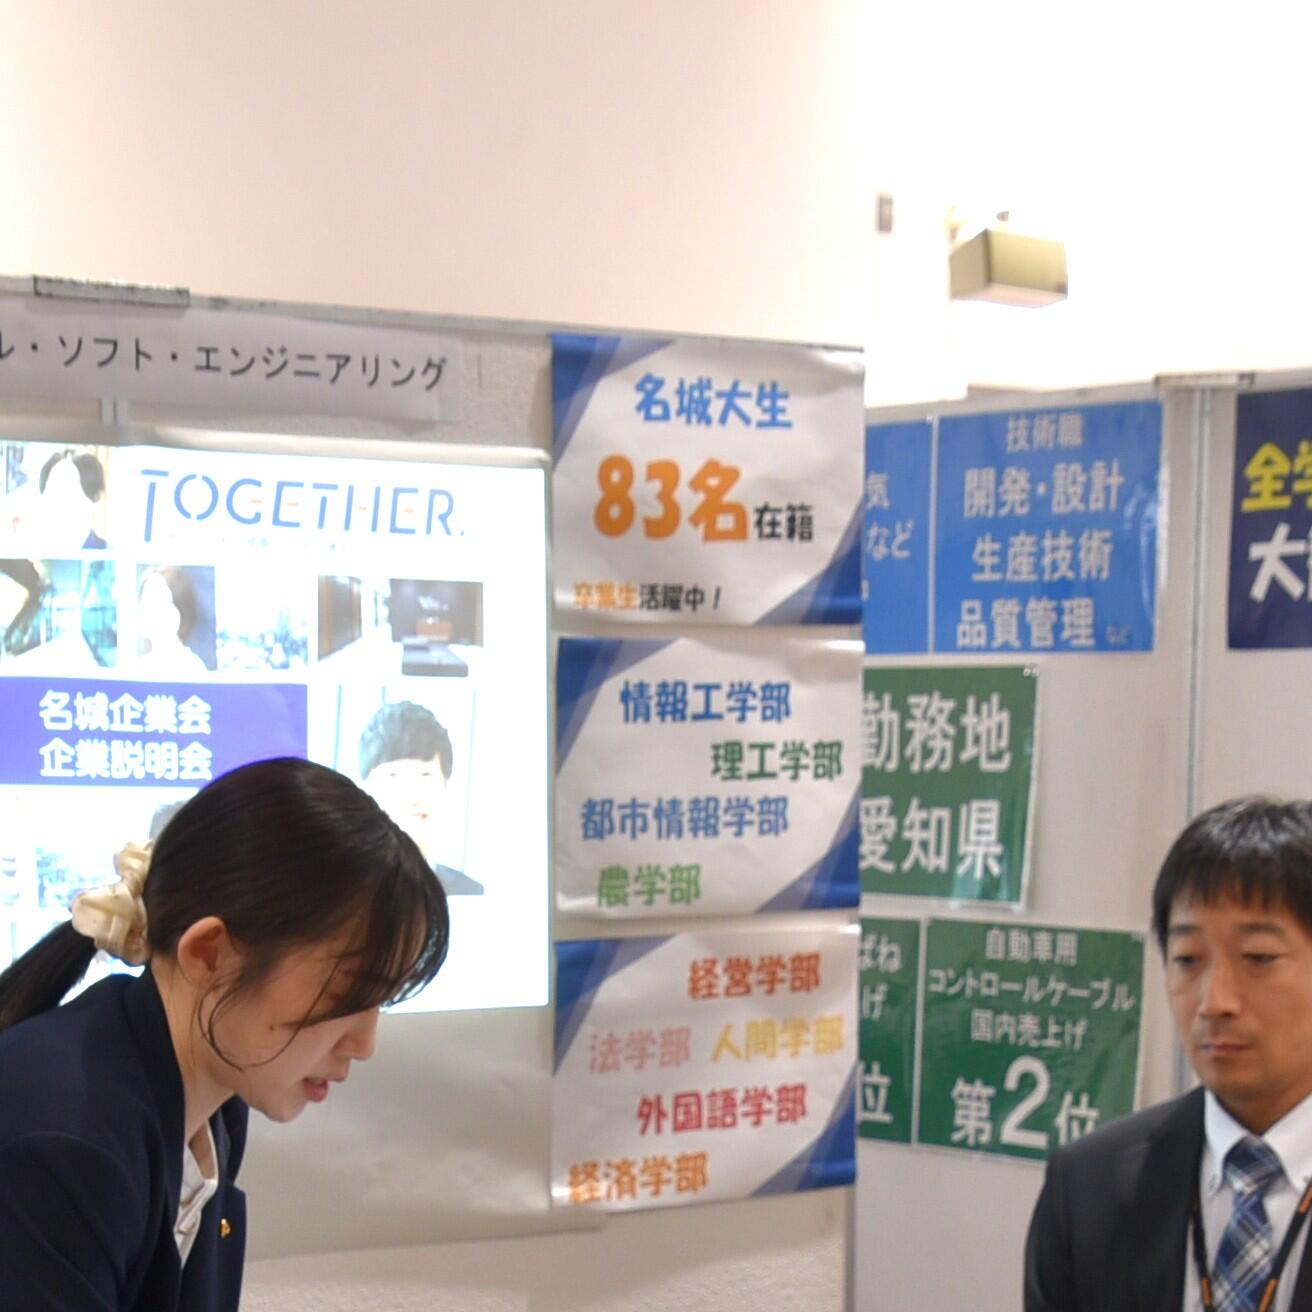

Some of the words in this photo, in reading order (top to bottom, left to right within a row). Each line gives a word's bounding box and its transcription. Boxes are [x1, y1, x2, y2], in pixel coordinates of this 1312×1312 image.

[634, 372, 793, 430] 名城大生
[1006, 412, 1084, 453] 技術職
[964, 459, 1124, 518] 開発・設計
[971, 529, 1114, 583] 生産技術
[956, 597, 1097, 649] 品質管理
[39, 690, 212, 734] 名城企業会
[620, 681, 792, 723] 情報工学部
[39, 737, 213, 781] 企業説明会
[710, 740, 844, 781] 理工学部
[580, 796, 789, 841] 都市情報学部
[859, 794, 1004, 881] 愛知県
[597, 863, 702, 908] 農学部
[986, 928, 1079, 967] 自動車用
[688, 953, 822, 1000] 経営学部
[928, 968, 1136, 1012] コントロールケーブル
[590, 1027, 693, 1074] 法学部
[711, 1015, 845, 1063] 人間学部
[970, 1008, 1087, 1051] 国内売上げ
[637, 1083, 808, 1136] 外国語学部
[568, 1152, 709, 1204] 経済学部
